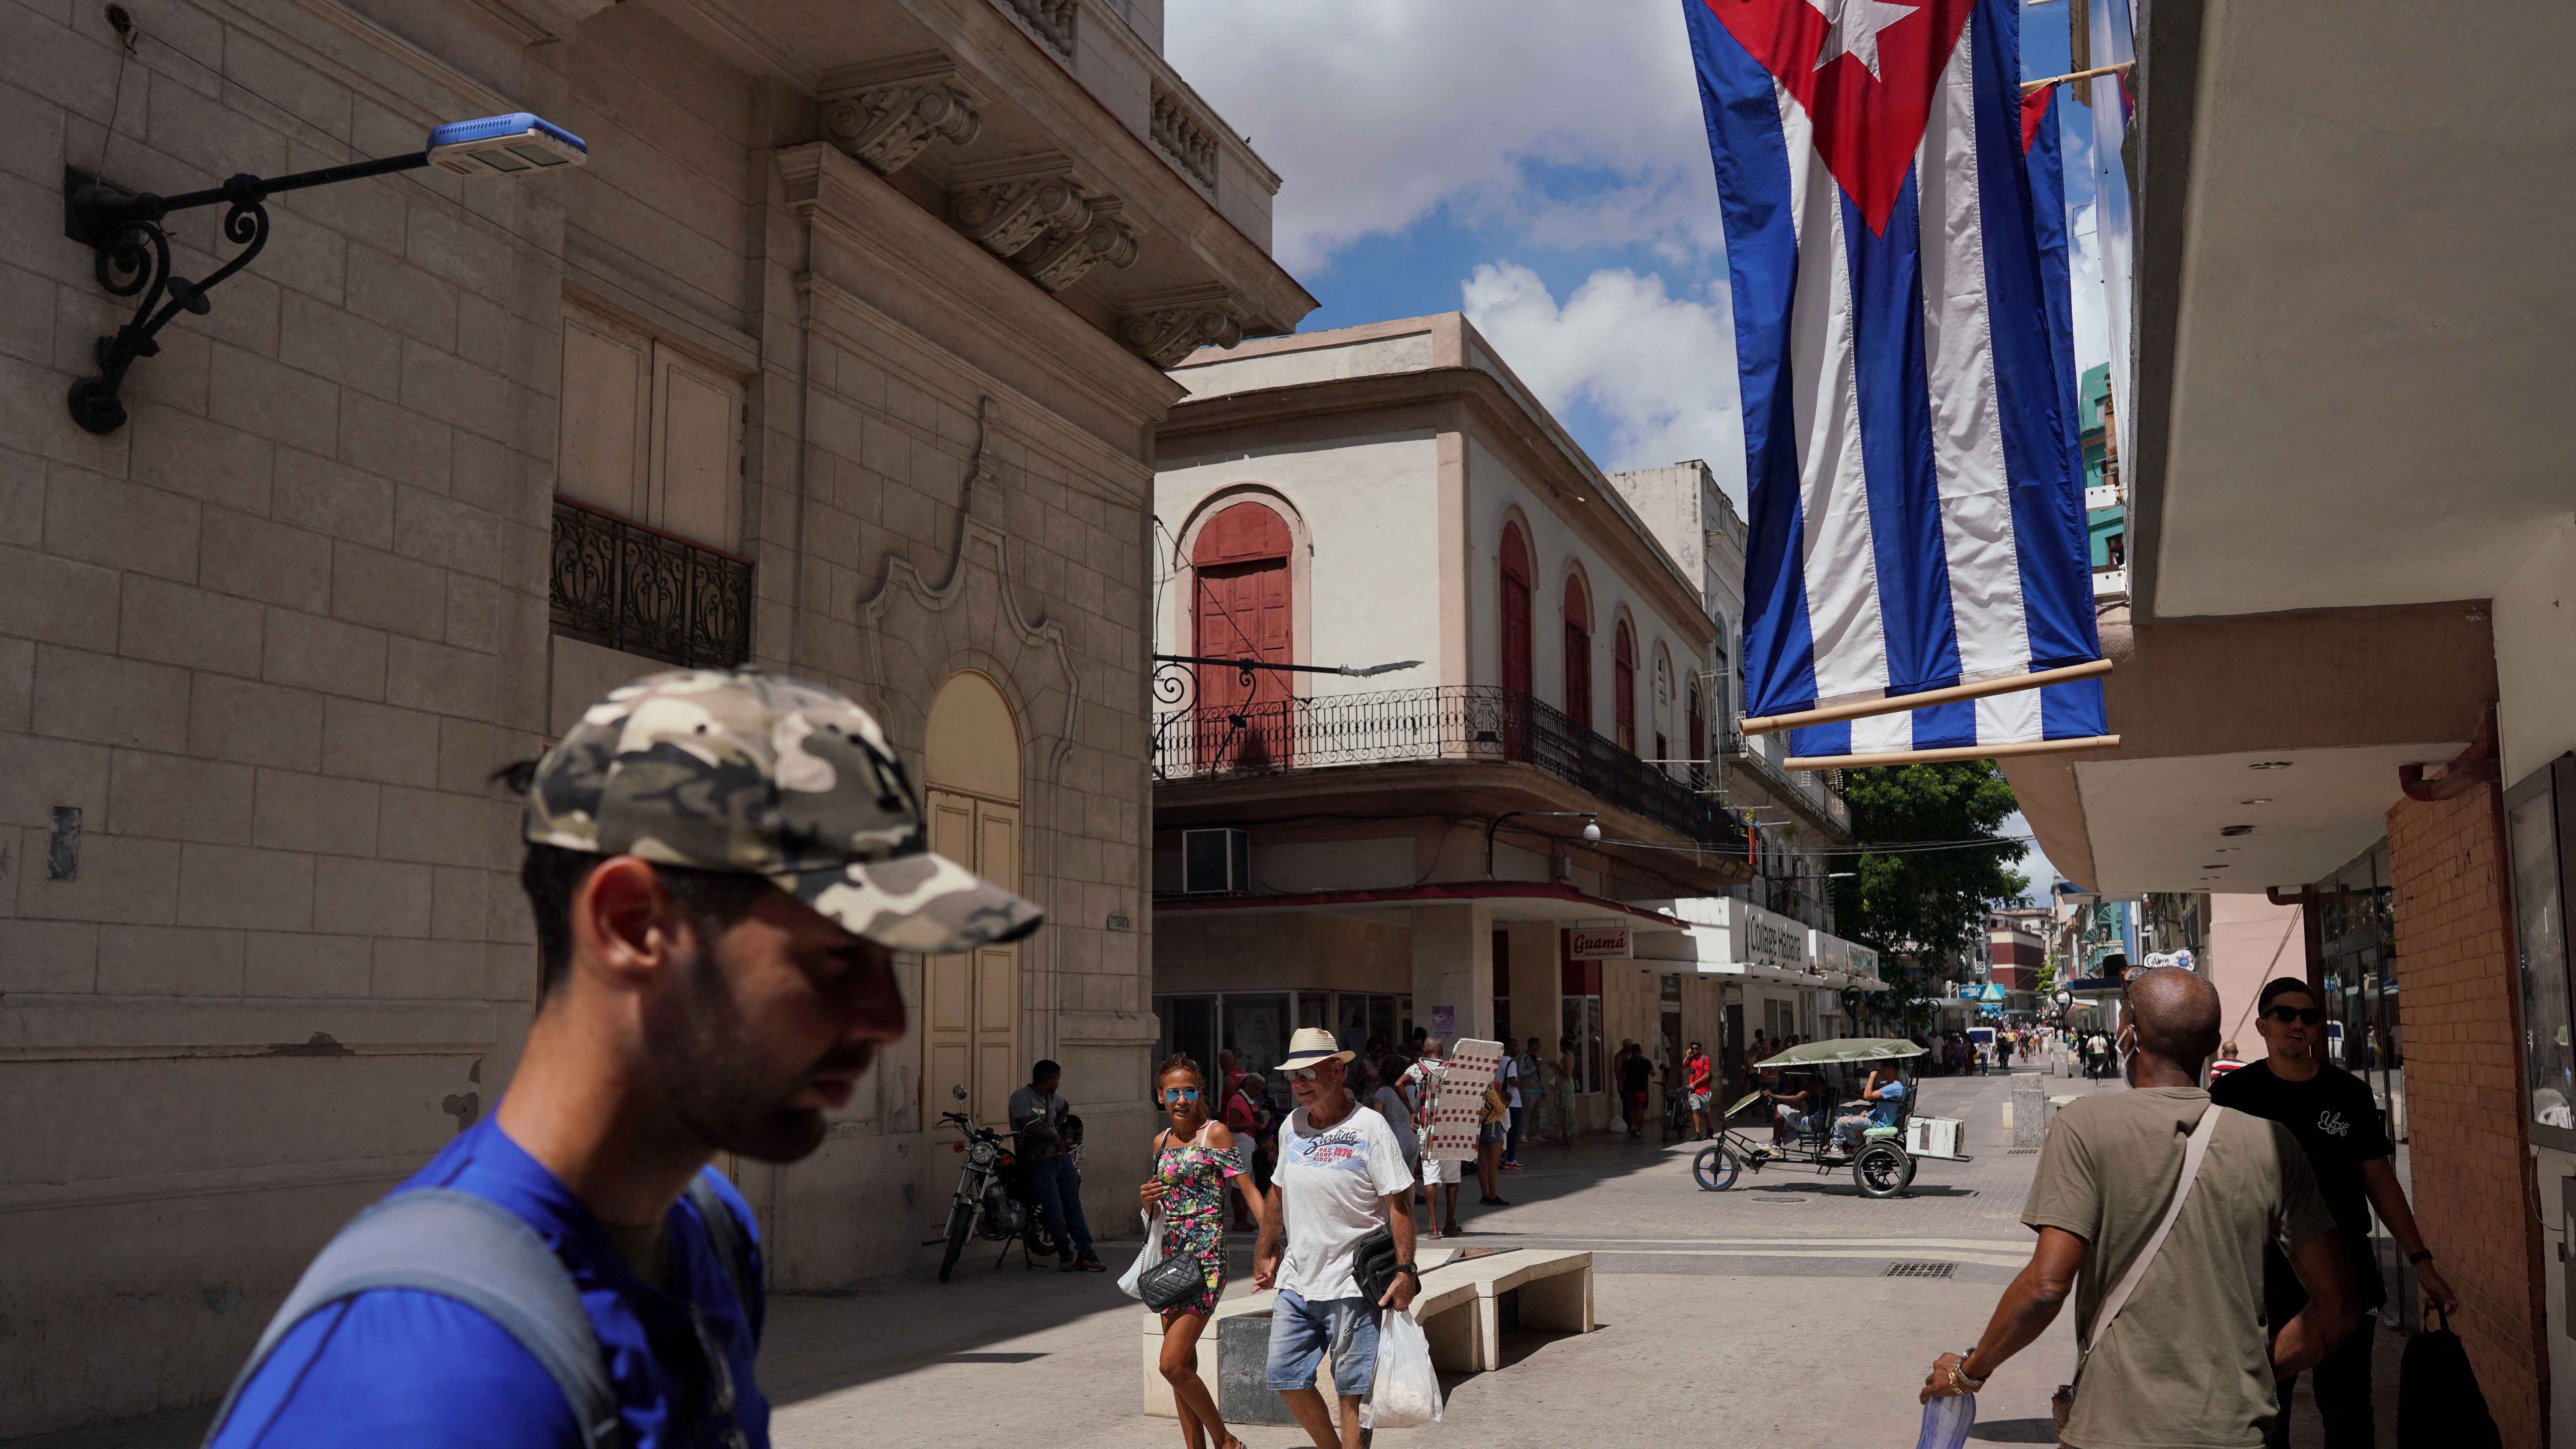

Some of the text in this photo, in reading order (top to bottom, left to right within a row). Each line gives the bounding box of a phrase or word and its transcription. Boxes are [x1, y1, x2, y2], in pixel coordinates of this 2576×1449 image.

[1574, 932, 1626, 954] Guamá
[1750, 914, 1801, 963] Collage Habana
[1303, 1129, 1357, 1156] Surfing
[1334, 1147, 1353, 1158] 1976
